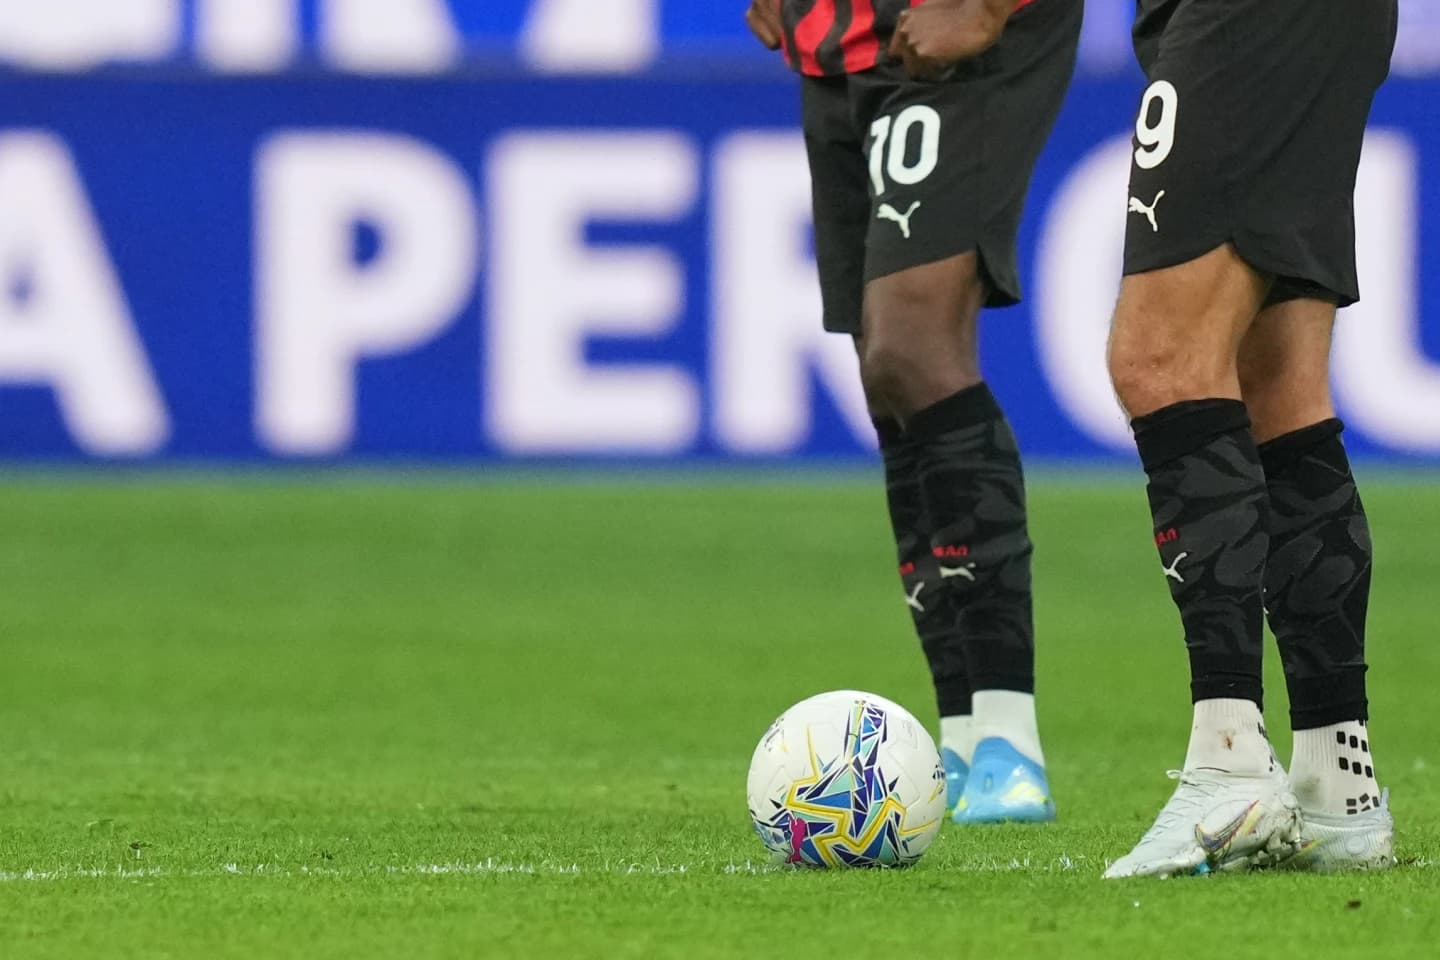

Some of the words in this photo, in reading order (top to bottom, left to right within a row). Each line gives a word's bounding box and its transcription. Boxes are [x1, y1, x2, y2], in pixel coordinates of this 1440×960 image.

[868, 104, 941, 196] 10
[1134, 78, 1178, 169] 9
[250, 125, 880, 457] PER
